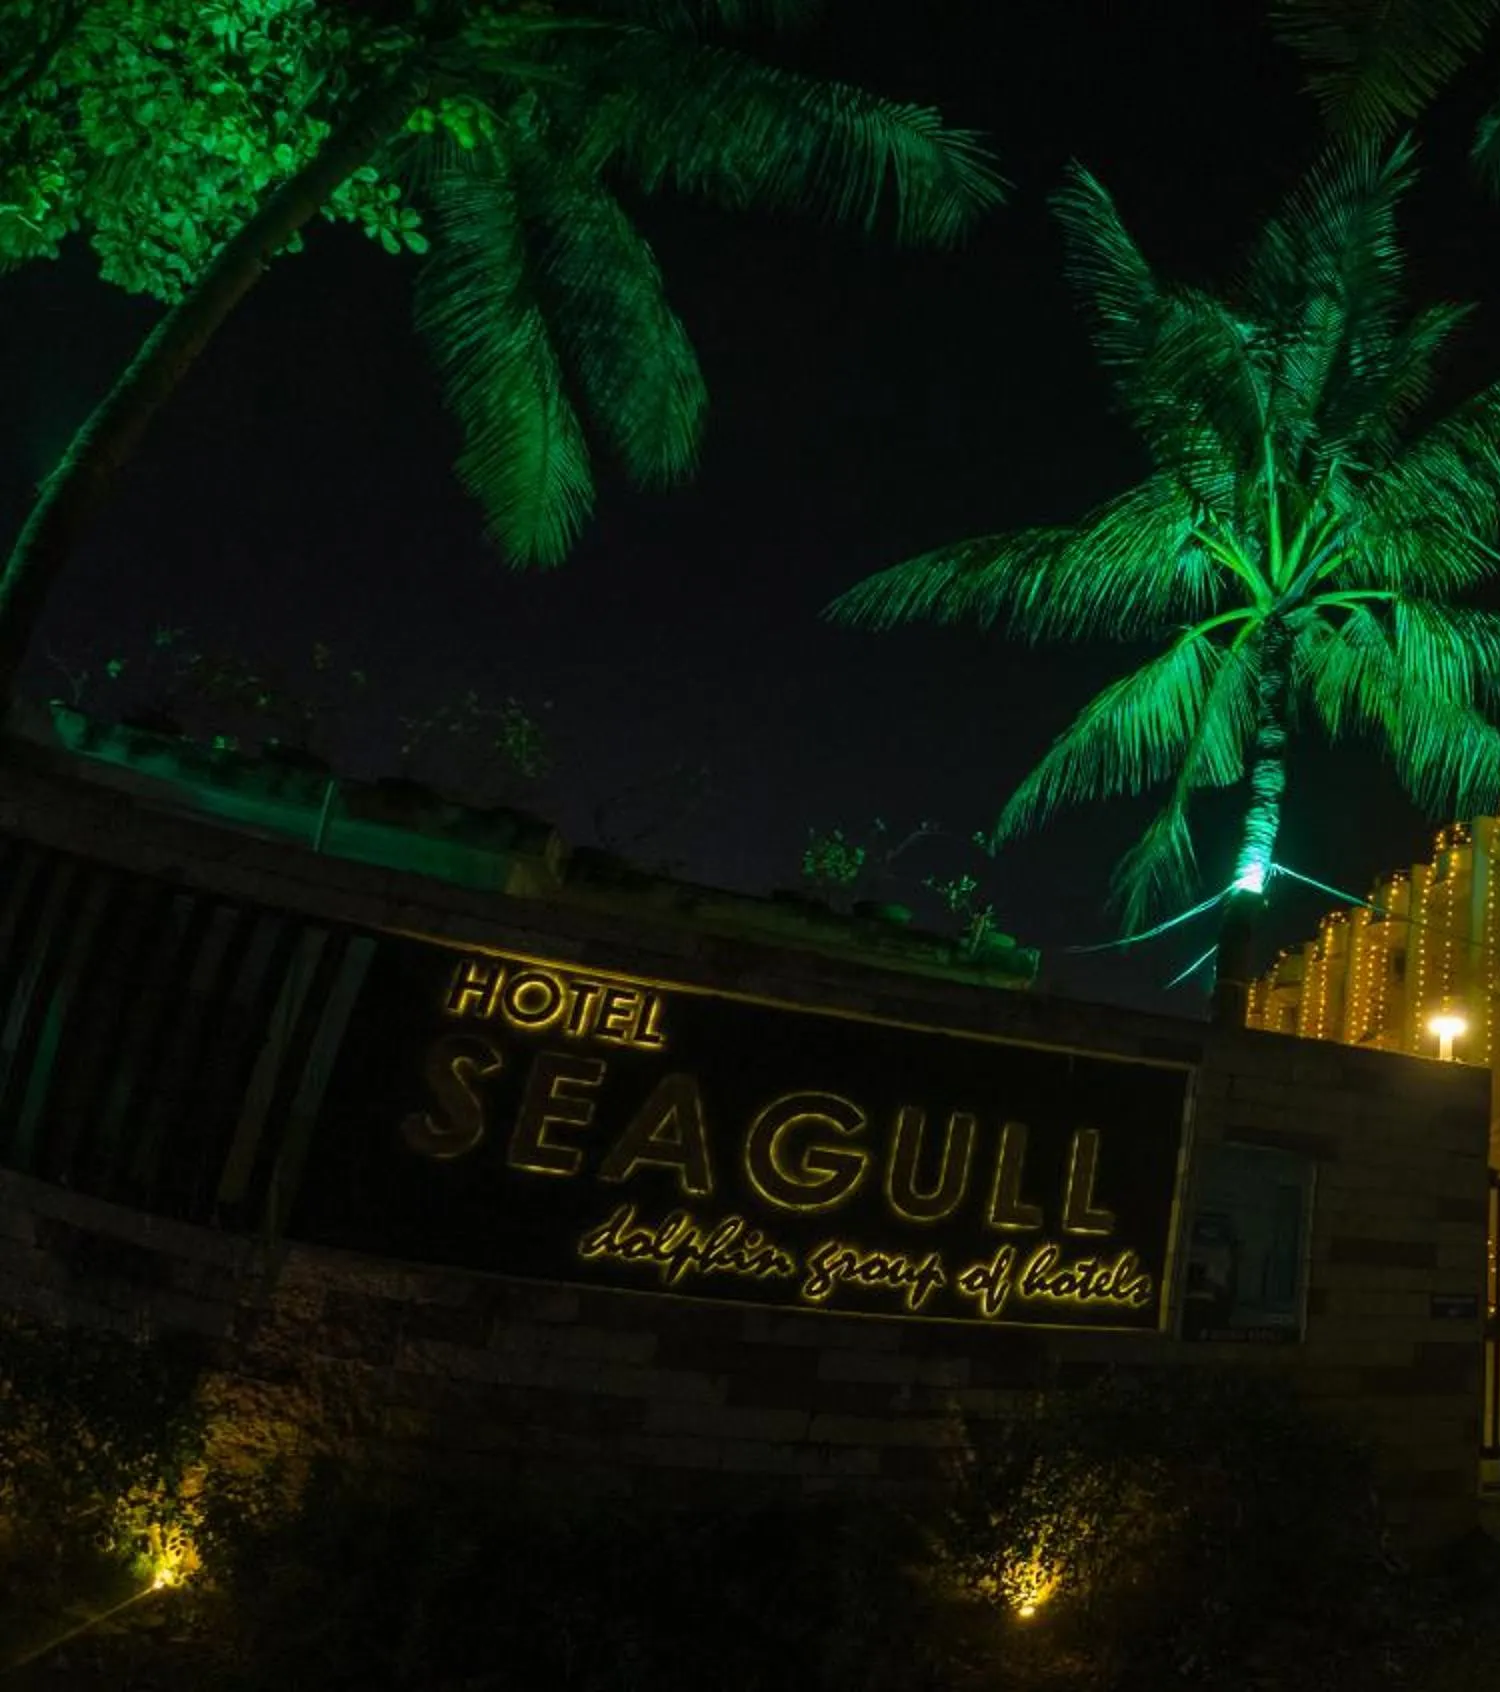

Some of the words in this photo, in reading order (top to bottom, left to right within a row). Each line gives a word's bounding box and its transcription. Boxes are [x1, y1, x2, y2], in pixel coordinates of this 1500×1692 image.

[446, 958, 667, 1051] HOTEL
[402, 1033, 1116, 1236] SEAGULL
[578, 1202, 792, 1285] dolphin
[799, 1238, 949, 1310] group
[955, 1246, 1014, 1318] of
[1017, 1244, 1154, 1308] hotels
